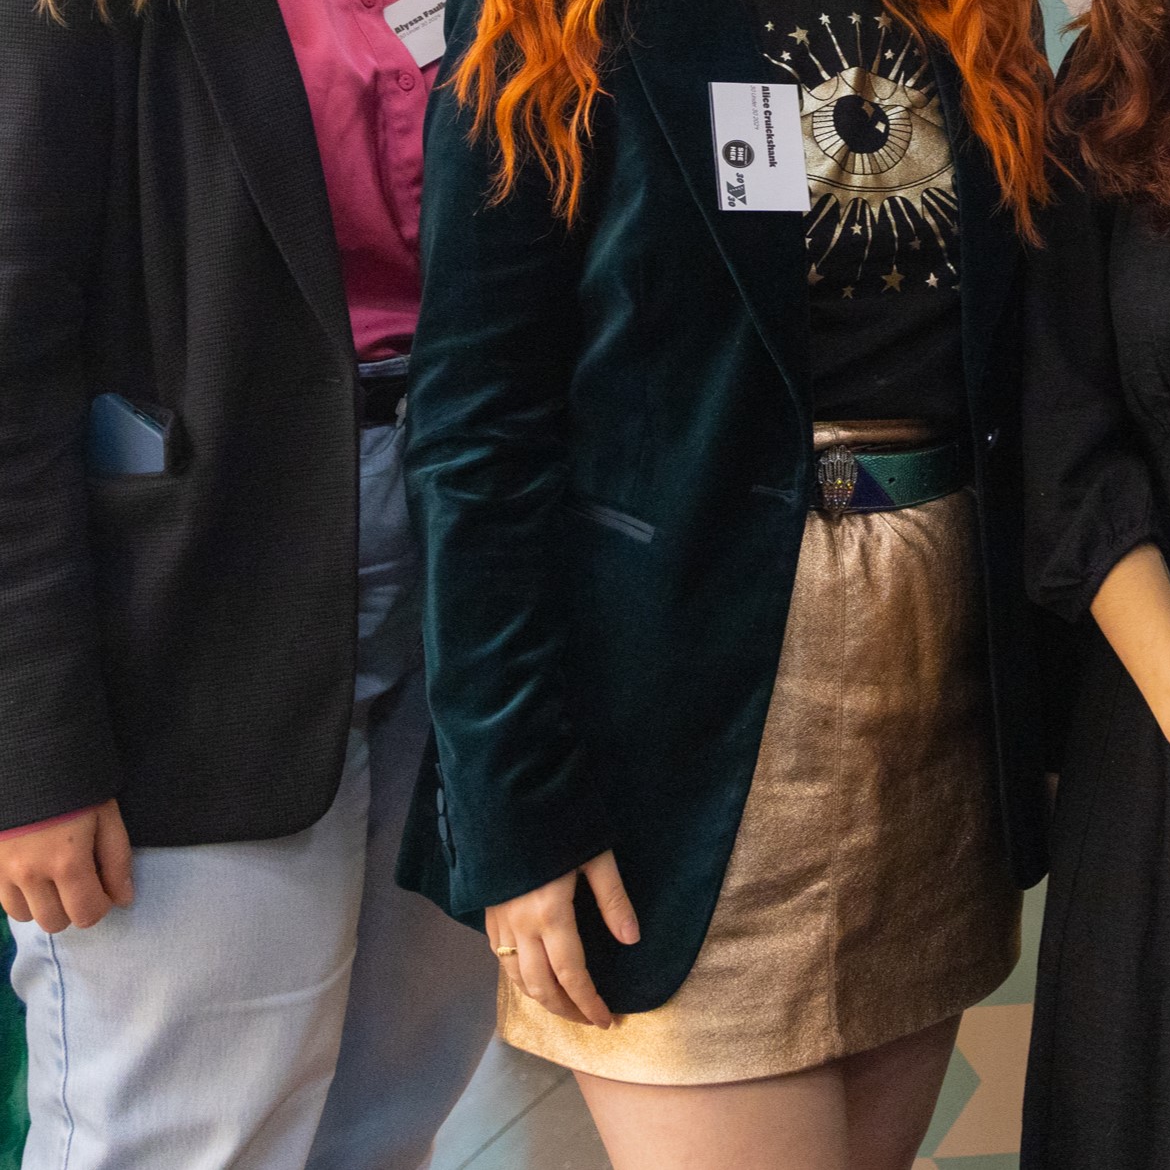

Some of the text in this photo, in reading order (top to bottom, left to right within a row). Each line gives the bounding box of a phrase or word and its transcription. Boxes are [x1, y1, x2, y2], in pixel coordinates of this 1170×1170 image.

[395, 16, 423, 34] Alyssa
[761, 85, 778, 168] Alice Cruickshank
[736, 172, 745, 184] 30
[727, 195, 737, 208] 30
